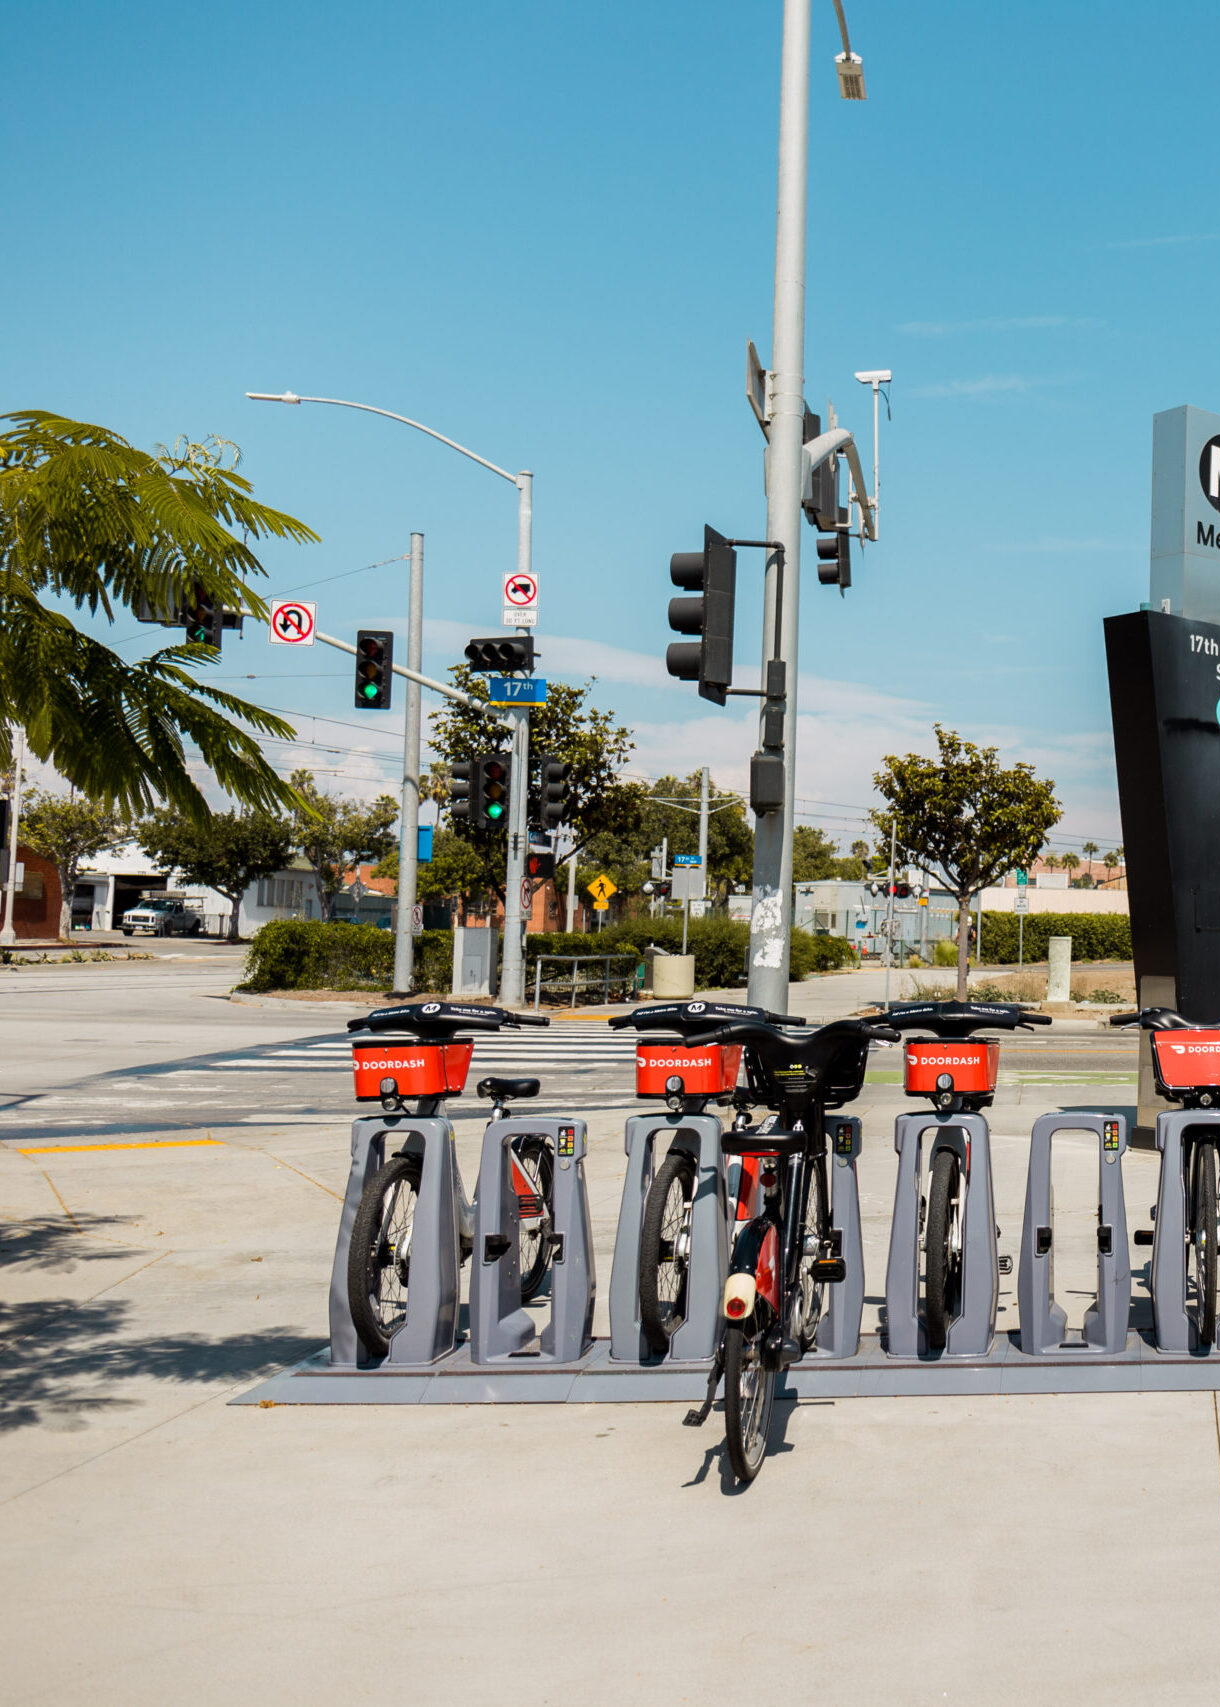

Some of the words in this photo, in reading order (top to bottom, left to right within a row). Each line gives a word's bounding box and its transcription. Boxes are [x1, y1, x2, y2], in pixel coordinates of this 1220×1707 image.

[1189, 633, 1219, 657] 17th
[503, 681, 533, 697] 17th
[362, 1058, 425, 1070] DOORDASH
[649, 1057, 712, 1068] DOORDASH
[921, 1056, 980, 1065] DOORDASH
